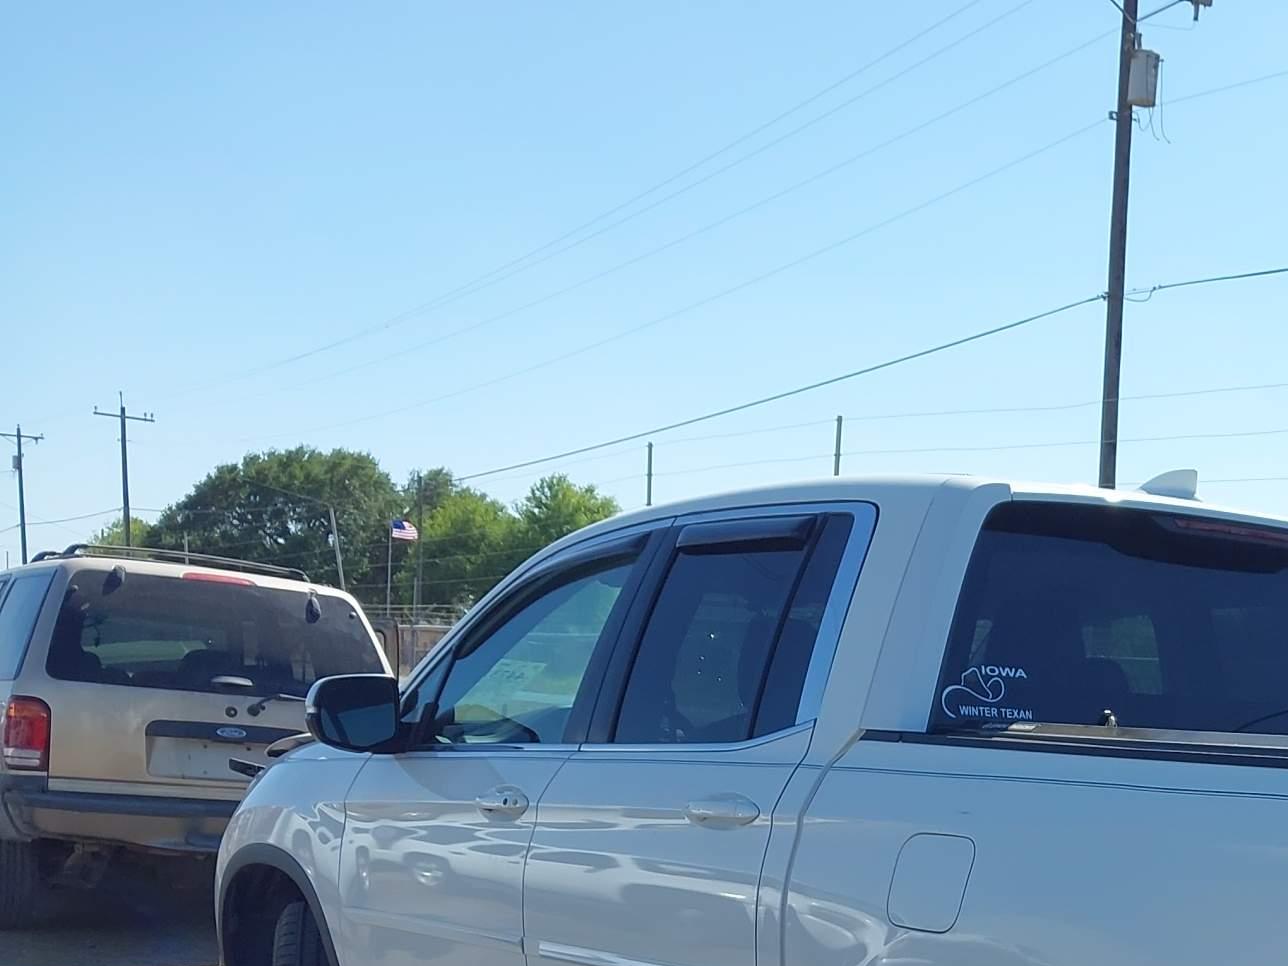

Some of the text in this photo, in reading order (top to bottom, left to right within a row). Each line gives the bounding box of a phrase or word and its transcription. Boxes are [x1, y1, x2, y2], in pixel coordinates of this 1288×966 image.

[981, 665, 1027, 679] IOWA
[959, 705, 1033, 720] WINTER TEXAN
